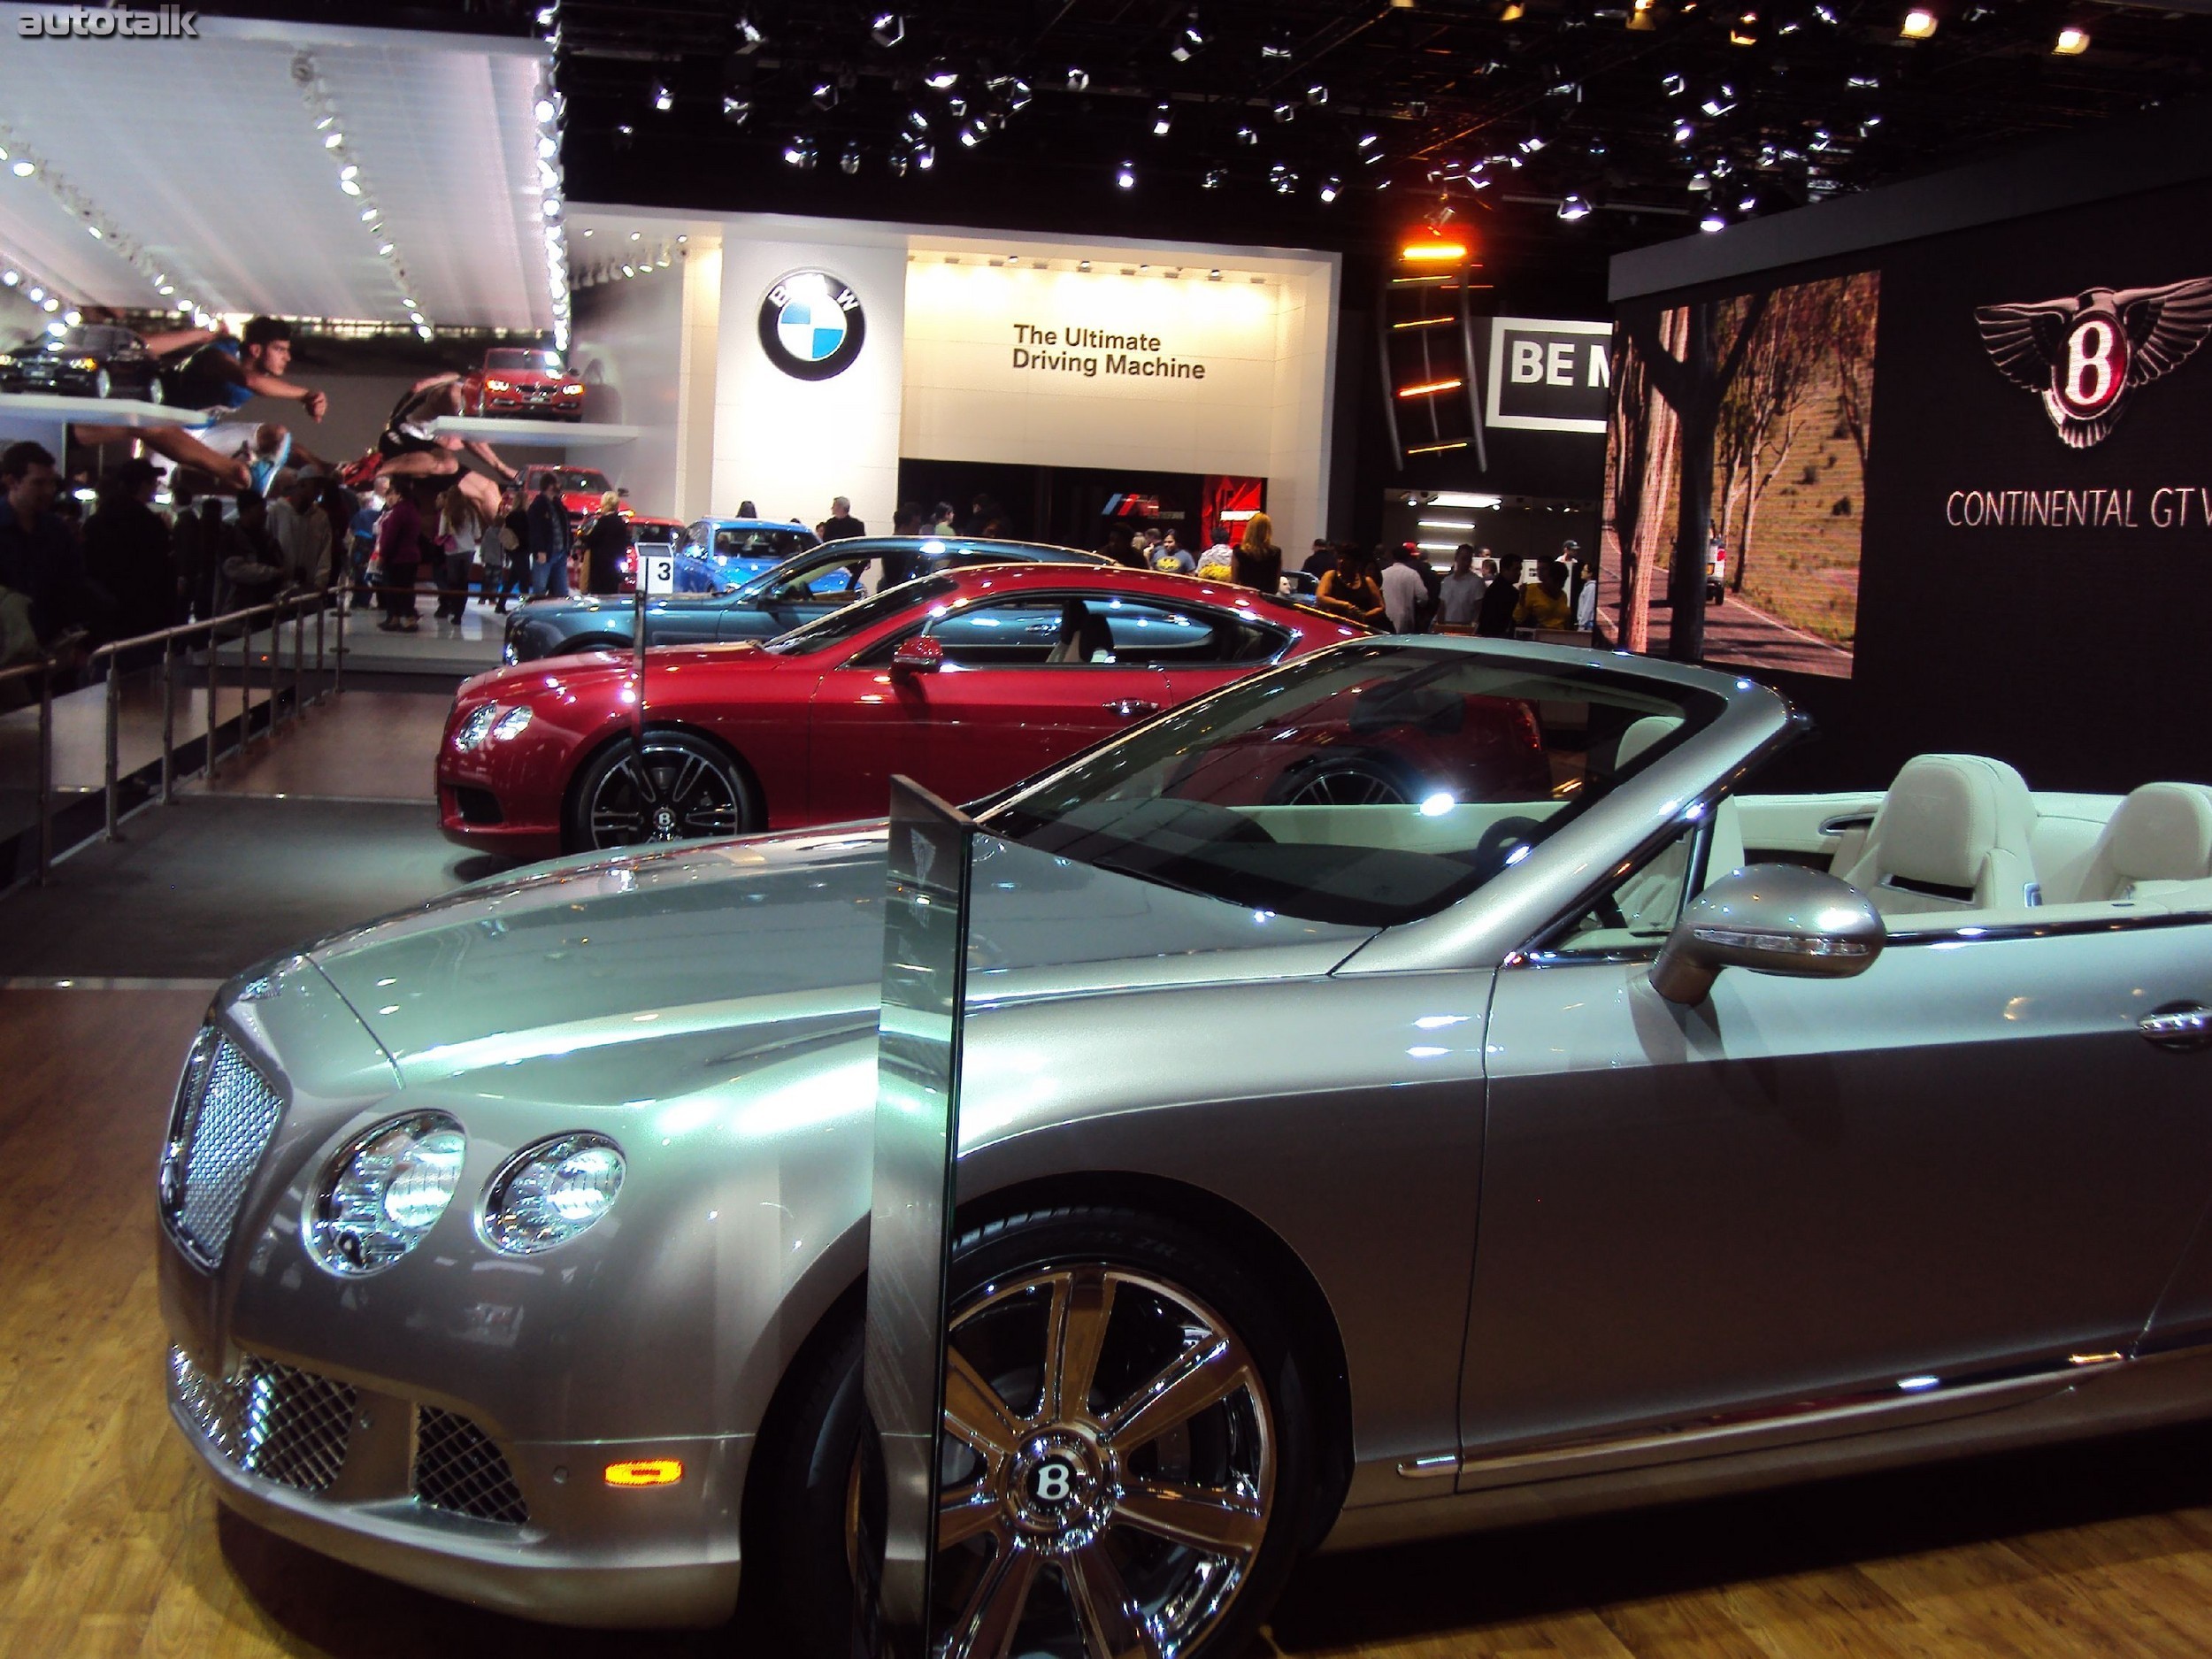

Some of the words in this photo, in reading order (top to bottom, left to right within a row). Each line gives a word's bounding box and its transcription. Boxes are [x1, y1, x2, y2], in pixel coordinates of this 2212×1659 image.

[1013, 324, 1056, 345] The
[1065, 327, 1161, 351] Ultimate
[1012, 348, 1097, 377] Driving
[1105, 354, 1206, 379] Machine
[1510, 341, 1575, 386] BE
[1947, 488, 2138, 526] CONTINENTAL
[2151, 488, 2195, 527] GT
[657, 562, 671, 580] 3
[658, 812, 671, 826] B
[1036, 1463, 1070, 1501] B
